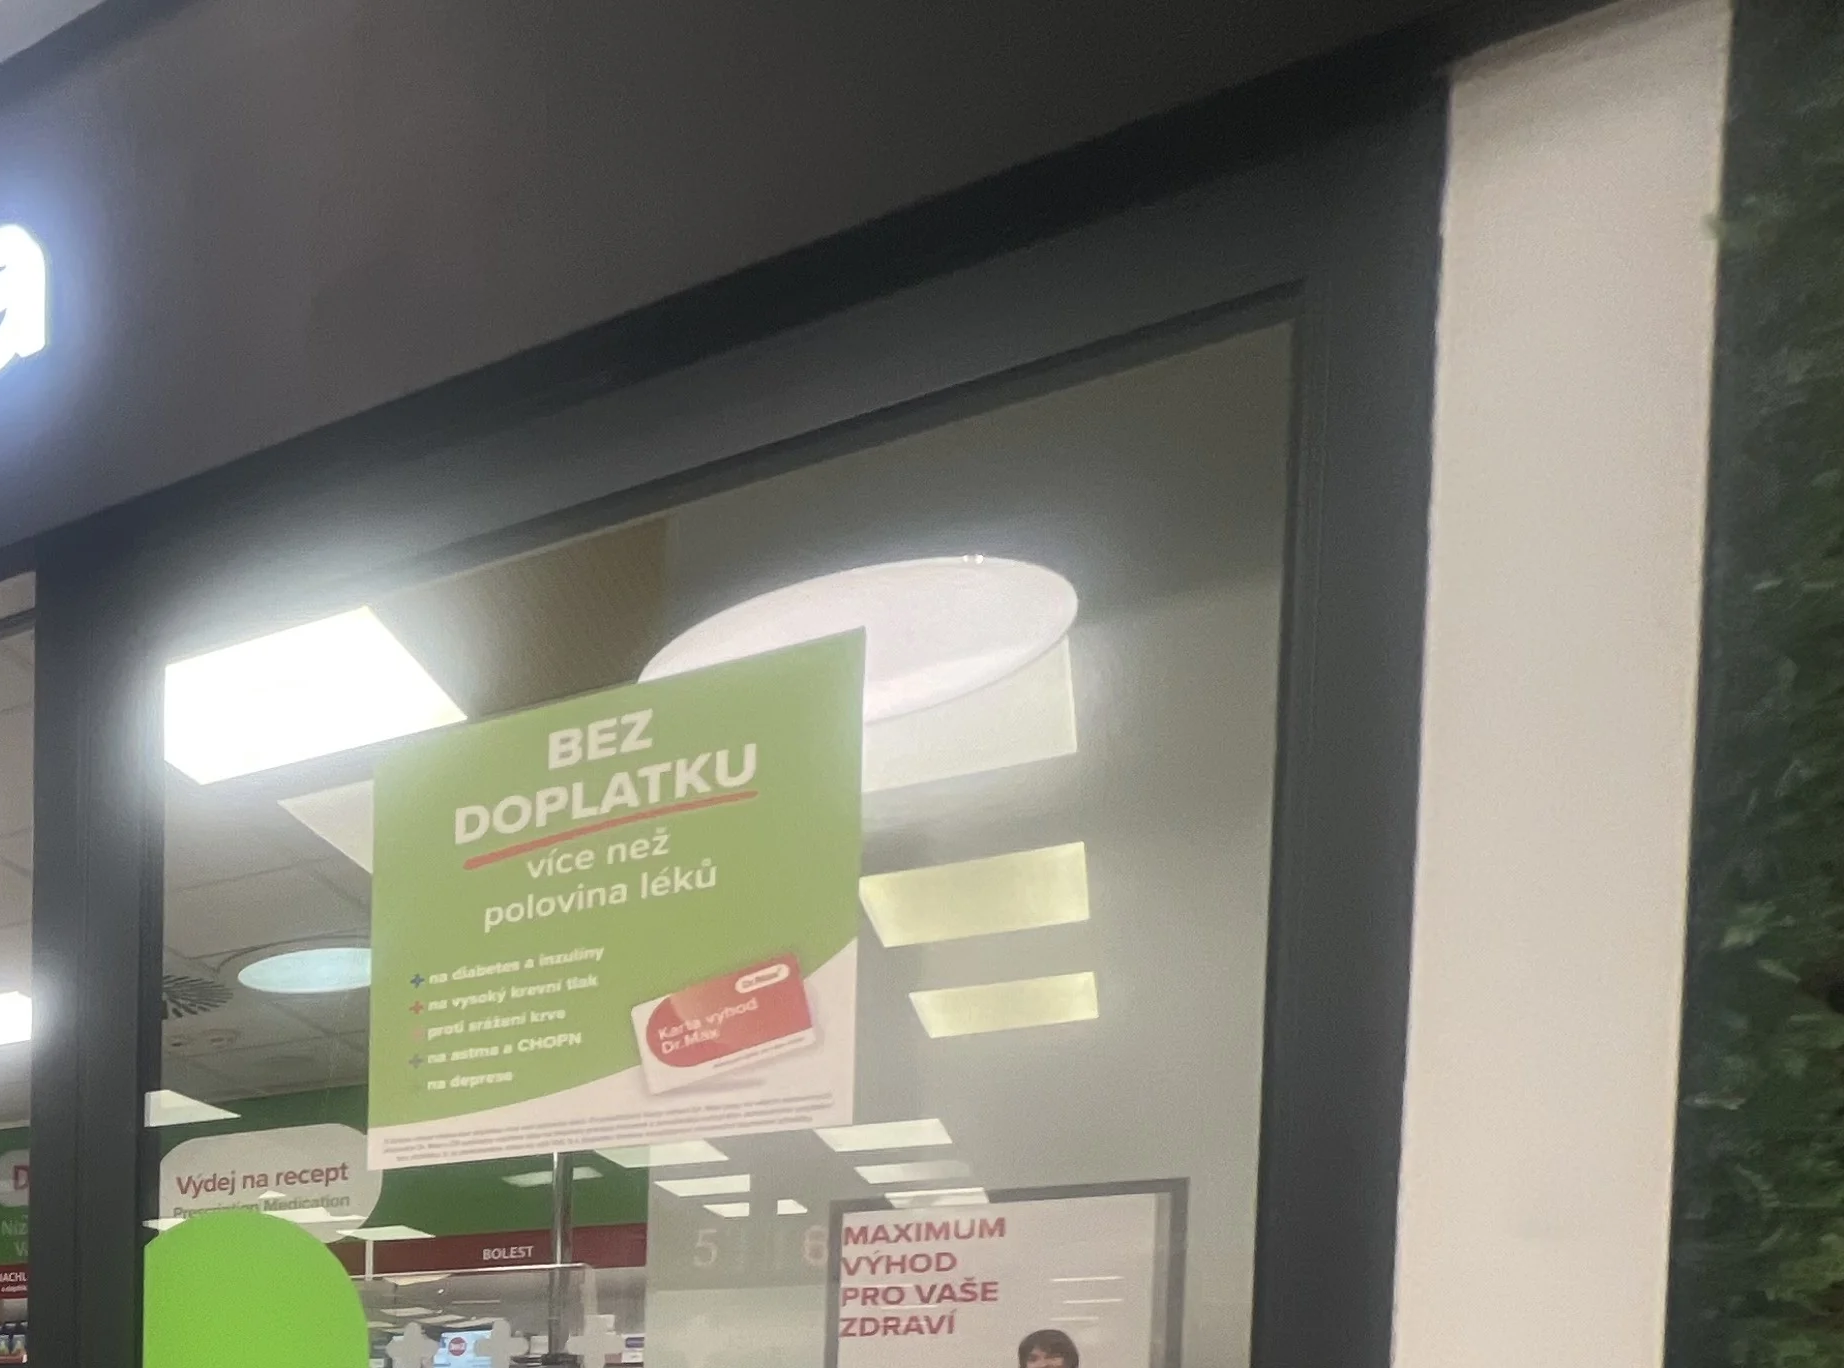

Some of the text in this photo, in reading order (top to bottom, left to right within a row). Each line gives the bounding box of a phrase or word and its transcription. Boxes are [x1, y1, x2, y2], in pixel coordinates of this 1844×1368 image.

[548, 708, 654, 771] BEZ
[455, 743, 757, 845] DOPLATKU
[526, 826, 671, 880] více než
[483, 857, 718, 933] polovina léků
[429, 972, 448, 985] na
[451, 959, 521, 981] diabetes
[524, 958, 535, 969] a
[427, 999, 448, 1011] na
[452, 987, 507, 1010] vysoký
[566, 974, 599, 991] tlak
[427, 1021, 464, 1041] proti
[530, 1009, 567, 1024] krve
[658, 1018, 702, 1041] Karta
[427, 1032, 583, 1064] na astma a CHOPN
[427, 1079, 447, 1091] na
[175, 1161, 350, 1200] Výdej na recept
[843, 1216, 1006, 1247] MAXIMUM
[482, 1243, 534, 1261] BOLEST
[842, 1250, 958, 1277] VÝHOD
[841, 1276, 1000, 1307] PRO VAŠE
[839, 1308, 957, 1338] ZDRAVÍ
